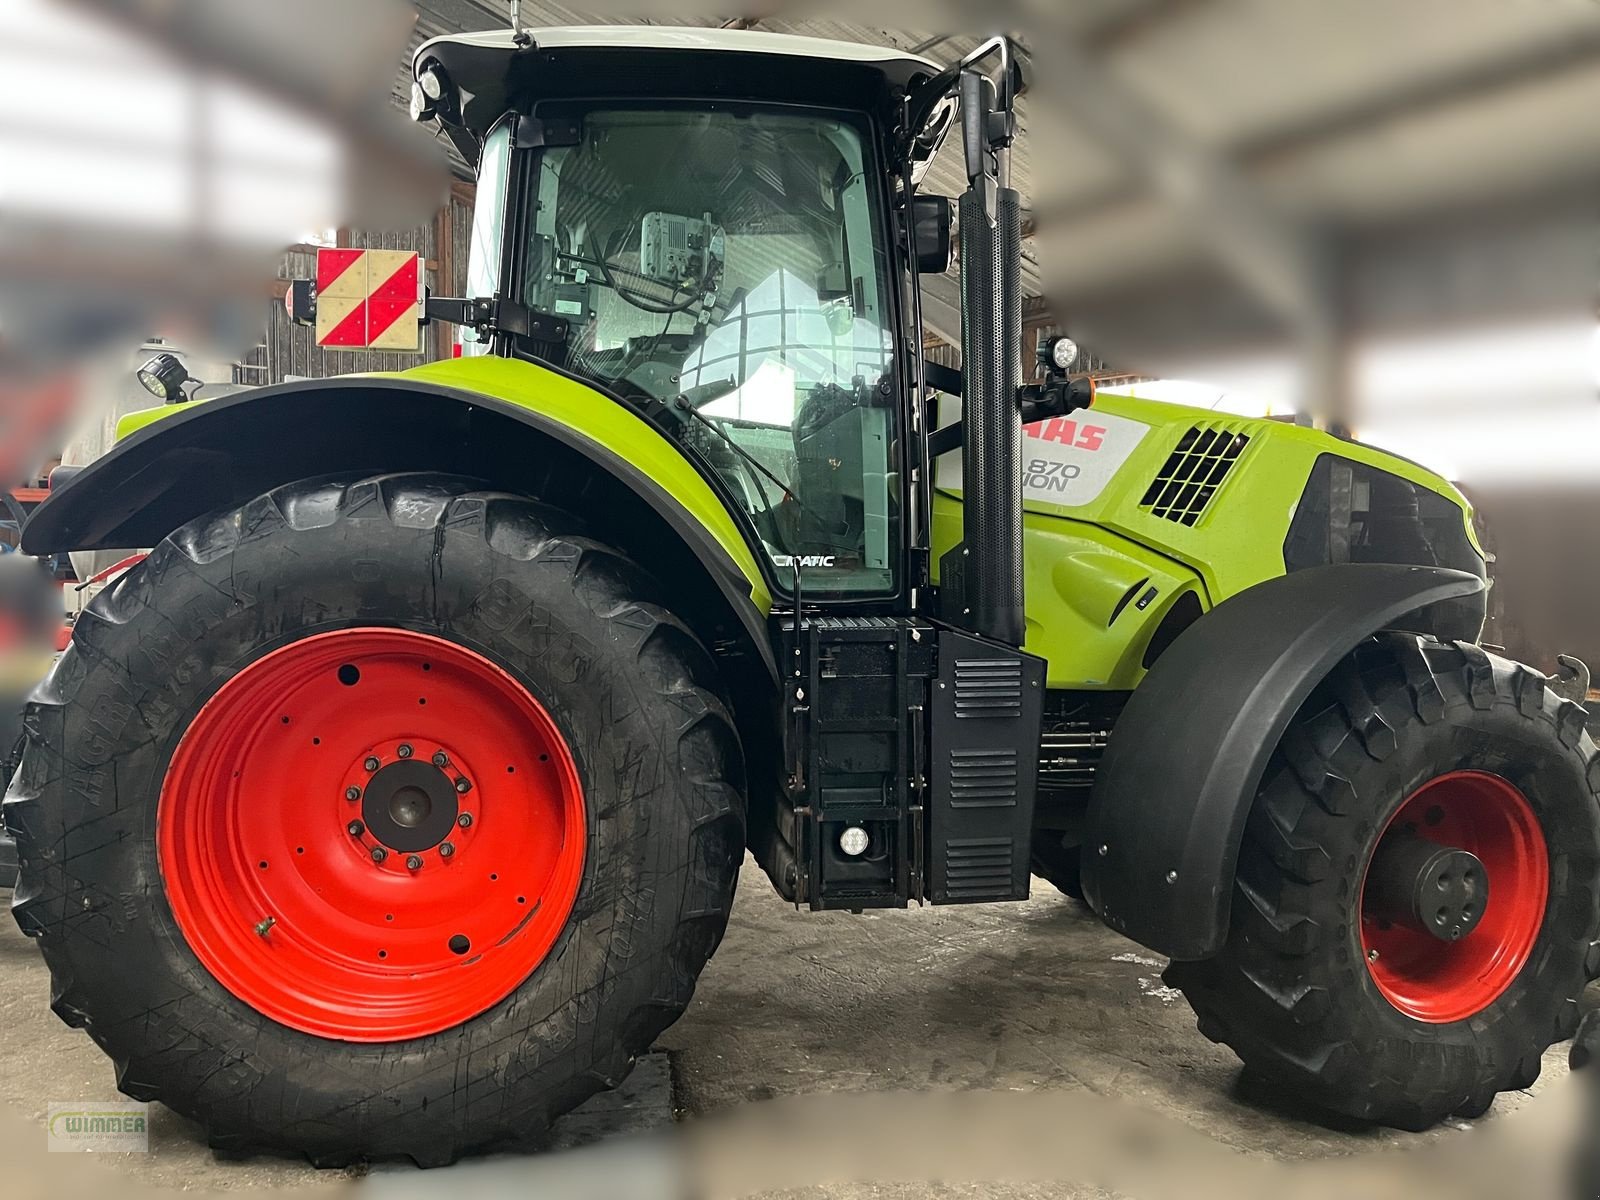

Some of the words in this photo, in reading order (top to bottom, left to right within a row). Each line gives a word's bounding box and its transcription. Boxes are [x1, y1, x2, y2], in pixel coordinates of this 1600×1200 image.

[1021, 416, 1107, 452] AAS
[1027, 459, 1081, 479] 870
[1022, 473, 1069, 493] ION
